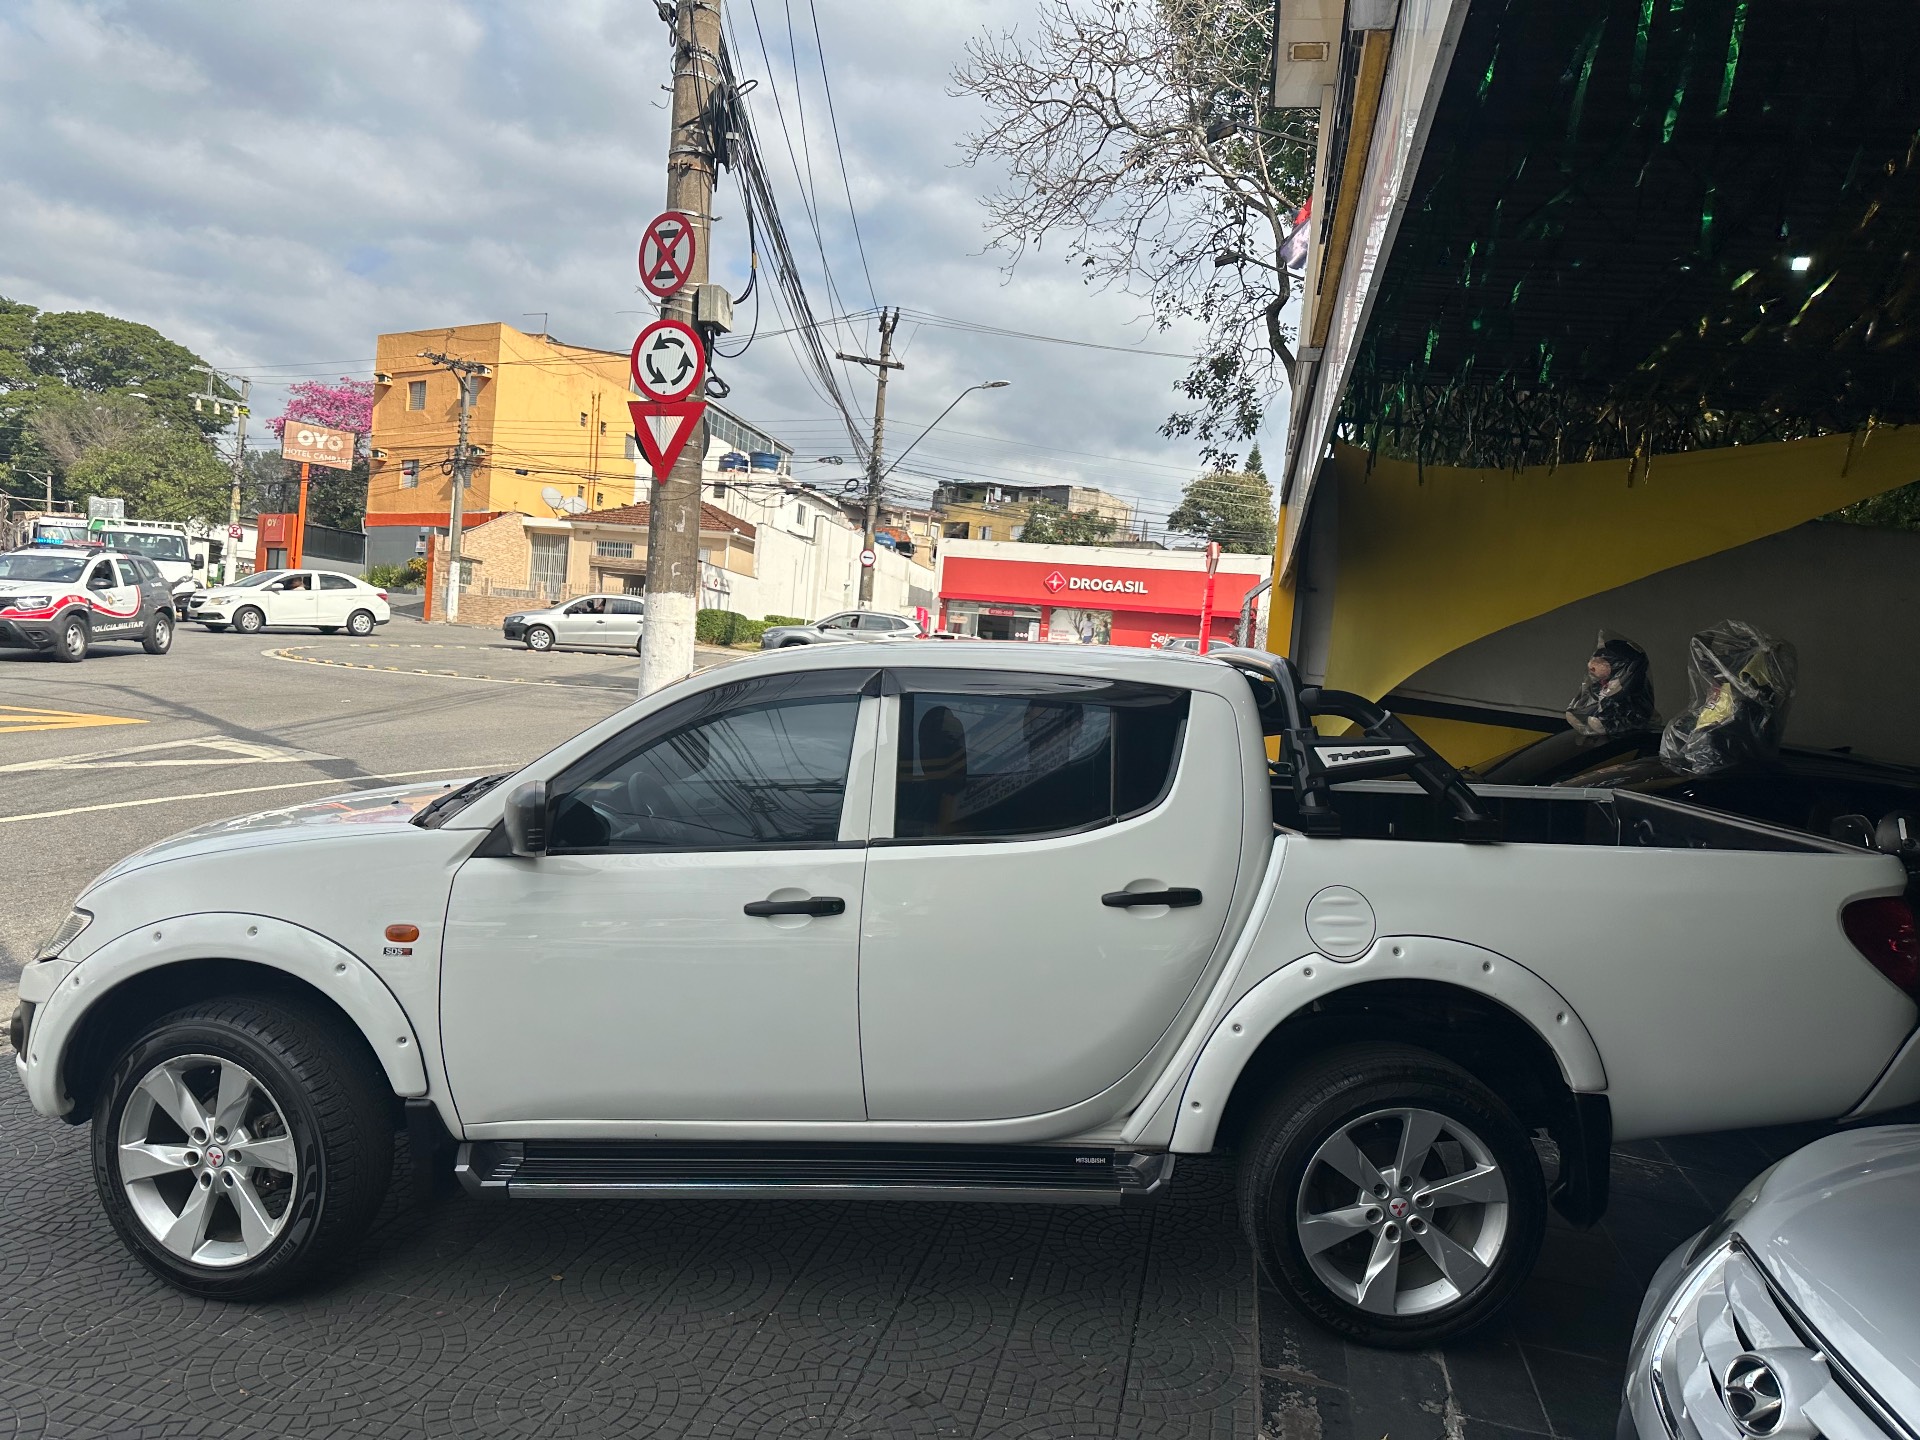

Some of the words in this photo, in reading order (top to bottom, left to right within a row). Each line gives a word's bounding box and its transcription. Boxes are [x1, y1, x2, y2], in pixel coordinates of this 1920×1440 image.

[297, 429, 344, 452] OYO
[284, 447, 311, 458] HOTEL
[1069, 577, 1149, 594] DROGASIL
[1150, 632, 1174, 645] Sej
[385, 947, 403, 955] SDS
